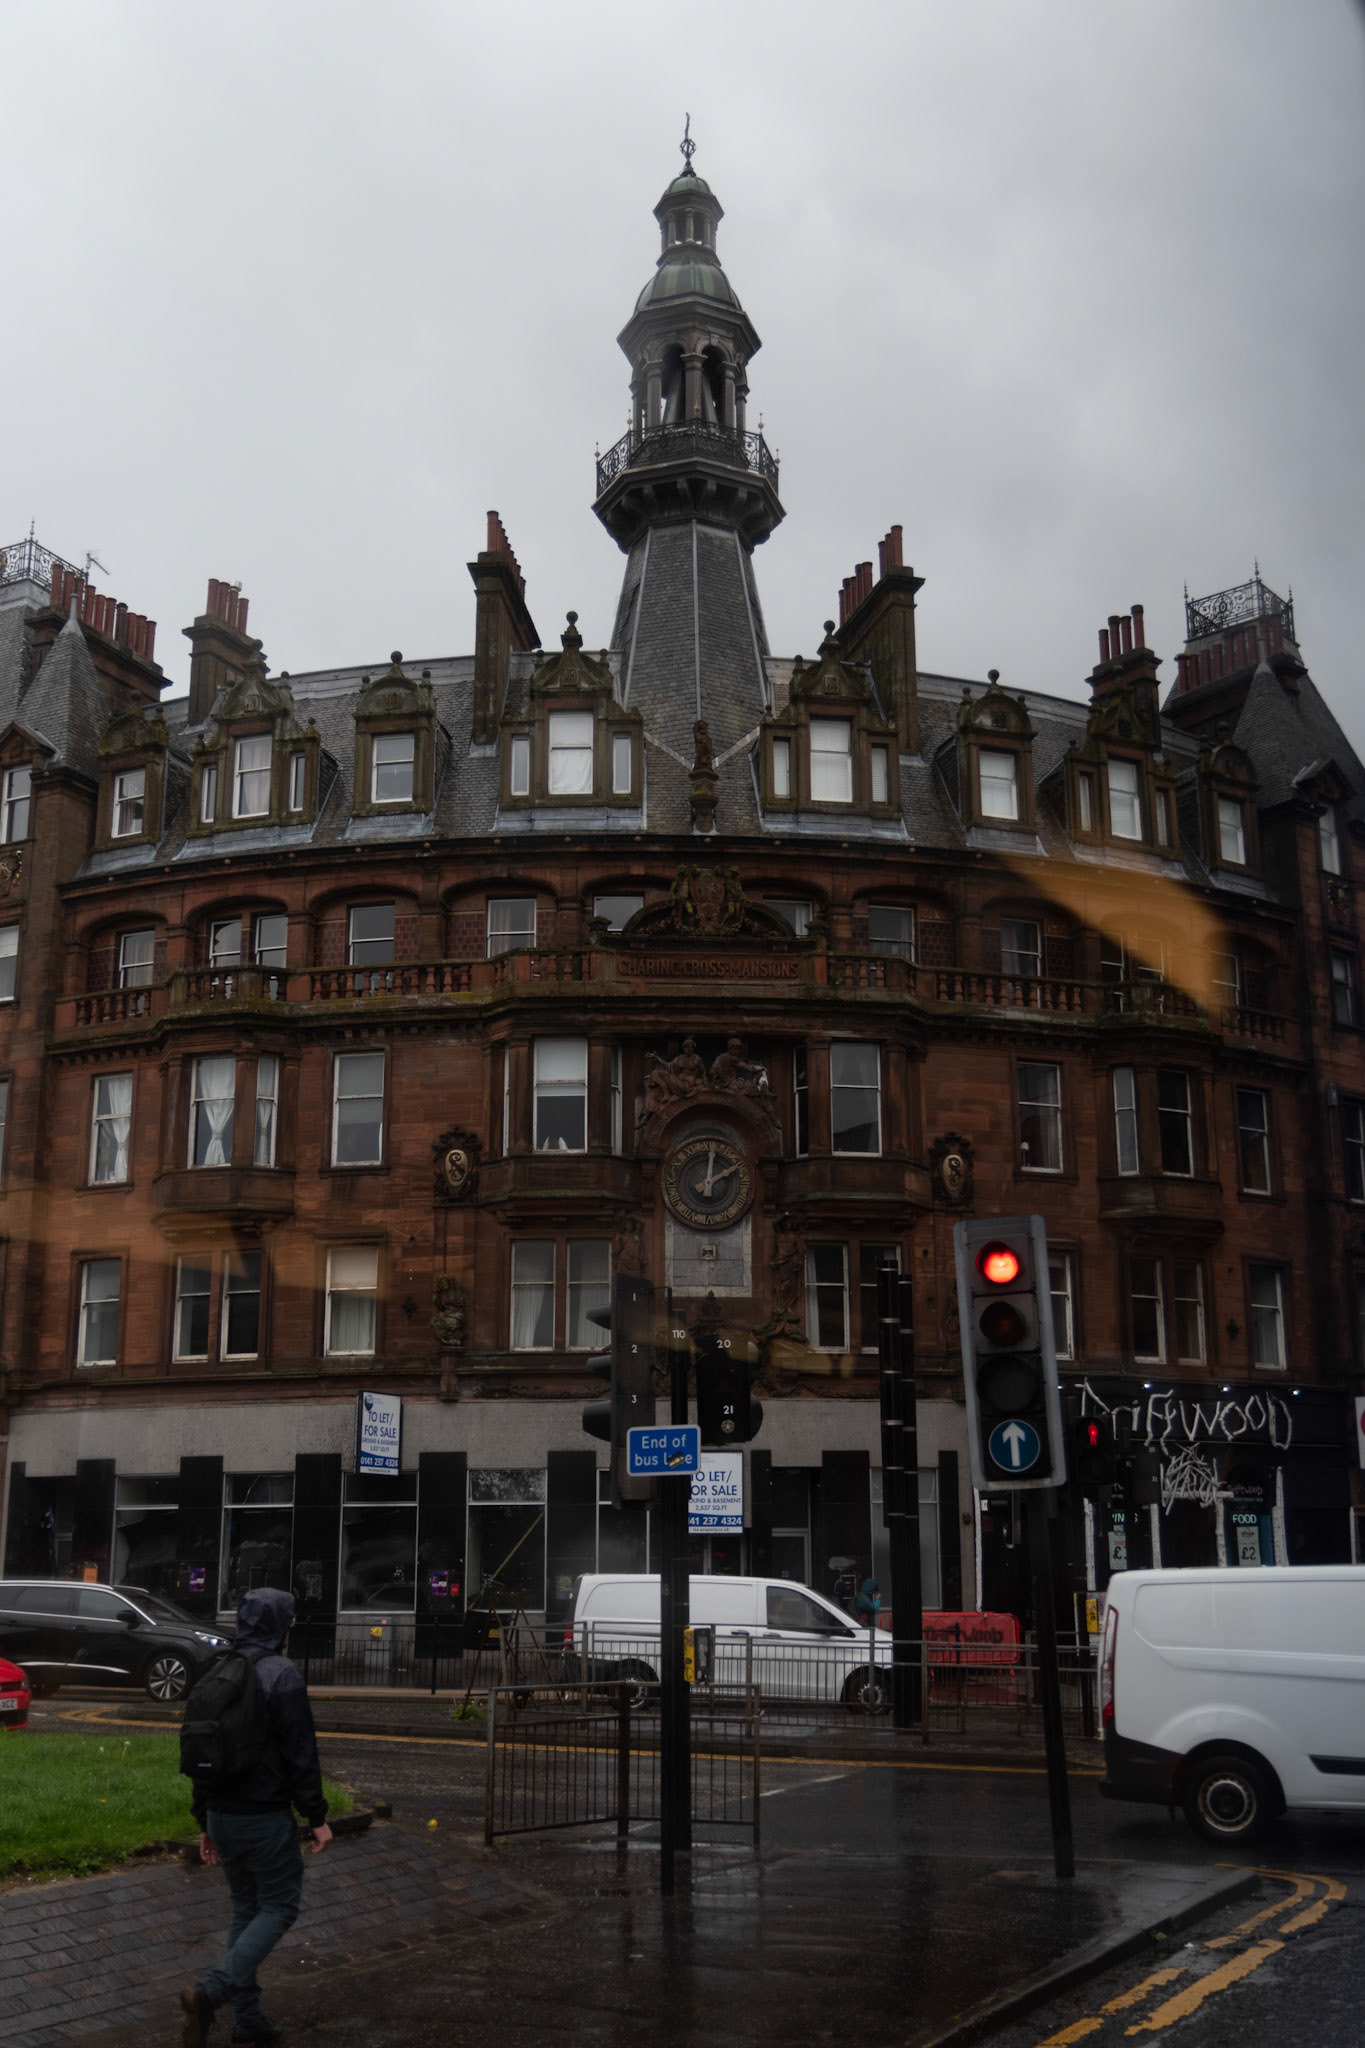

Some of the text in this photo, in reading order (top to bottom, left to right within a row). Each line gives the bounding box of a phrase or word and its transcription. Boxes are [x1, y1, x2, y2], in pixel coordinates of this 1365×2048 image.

[631, 1344, 638, 1354] 2
[716, 1339, 732, 1349] 20
[631, 1394, 638, 1404] 3
[722, 1404, 735, 1414] 21
[368, 1411, 394, 1426] TO LET/
[364, 1424, 397, 1439] FOR SALE
[641, 1434, 687, 1449] End of
[361, 1456, 398, 1468] 0141 237 4324
[635, 1453, 659, 1466] bus
[663, 1452, 693, 1466] le
[709, 1470, 732, 1483] LET/
[691, 1485, 737, 1496] OR SALE
[702, 1516, 717, 1525] 237
[720, 1516, 742, 1526] 4324
[1231, 1513, 1258, 1524] FOOD
[1241, 1547, 1257, 1561] £2
